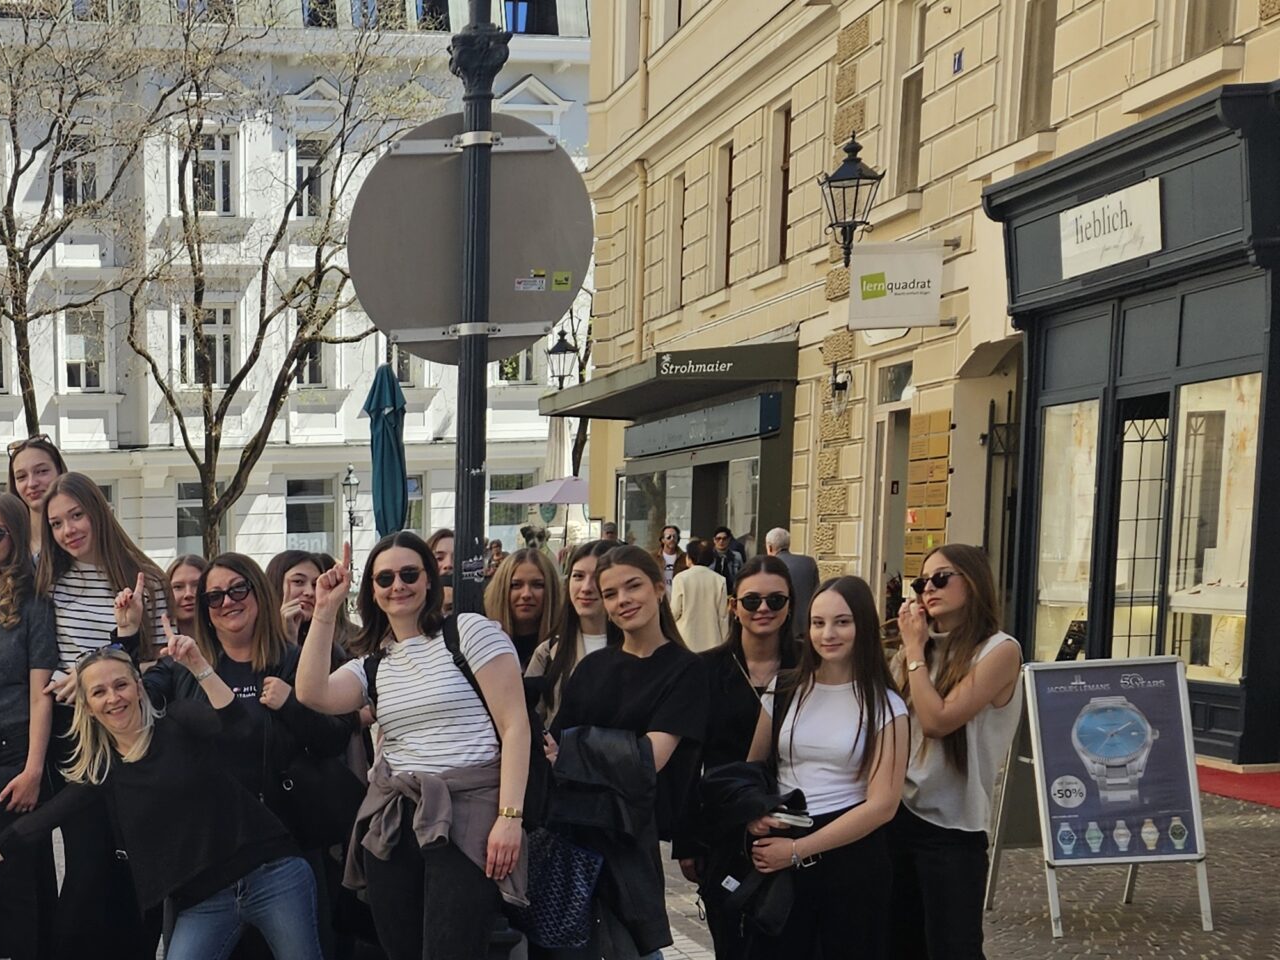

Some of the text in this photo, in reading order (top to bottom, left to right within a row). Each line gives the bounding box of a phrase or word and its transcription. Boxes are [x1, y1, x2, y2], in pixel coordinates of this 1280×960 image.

[1075, 200, 1133, 245] lieblich.
[660, 360, 734, 375] Strohmaier
[1053, 788, 1084, 799] -50%
